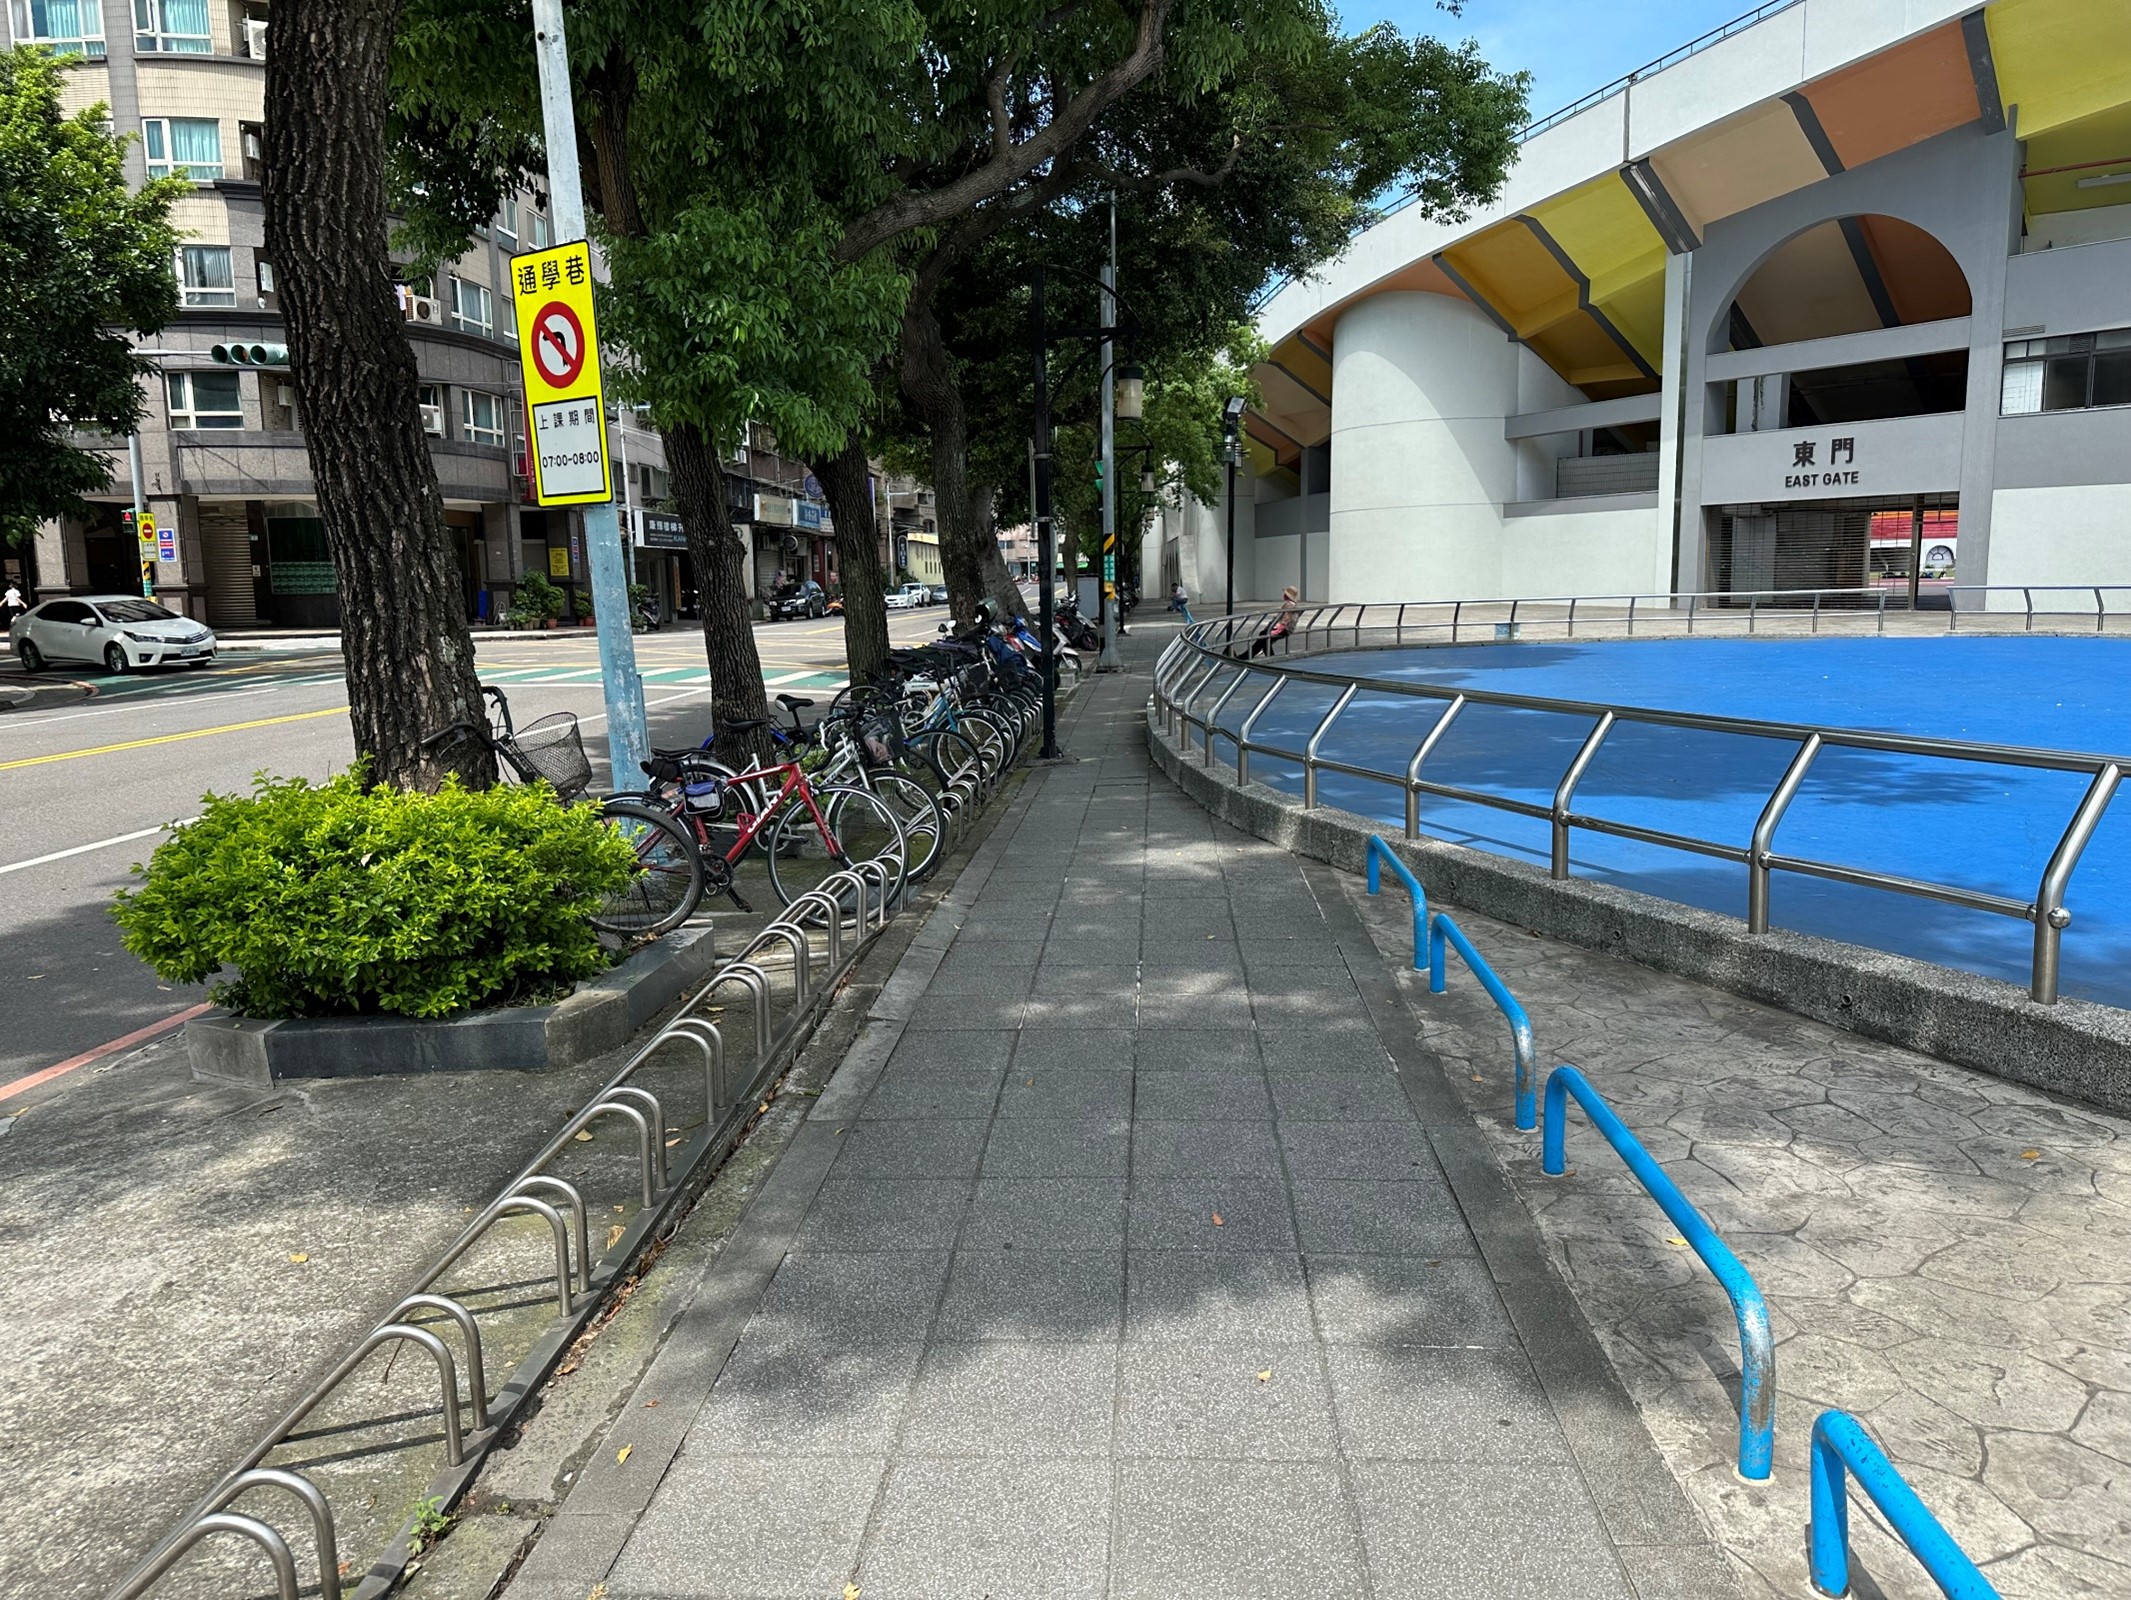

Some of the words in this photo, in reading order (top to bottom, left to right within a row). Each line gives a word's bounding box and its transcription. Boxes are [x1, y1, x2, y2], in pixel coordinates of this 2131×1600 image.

[518, 255, 585, 296] 通學巷
[539, 408, 595, 430] 上課期間
[542, 451, 600, 468] 07:00-08:00
[1792, 437, 1855, 468] 東門
[1785, 474, 1819, 488] EAST
[1823, 471, 1860, 486] GATE
[747, 788, 784, 834] GIANT
